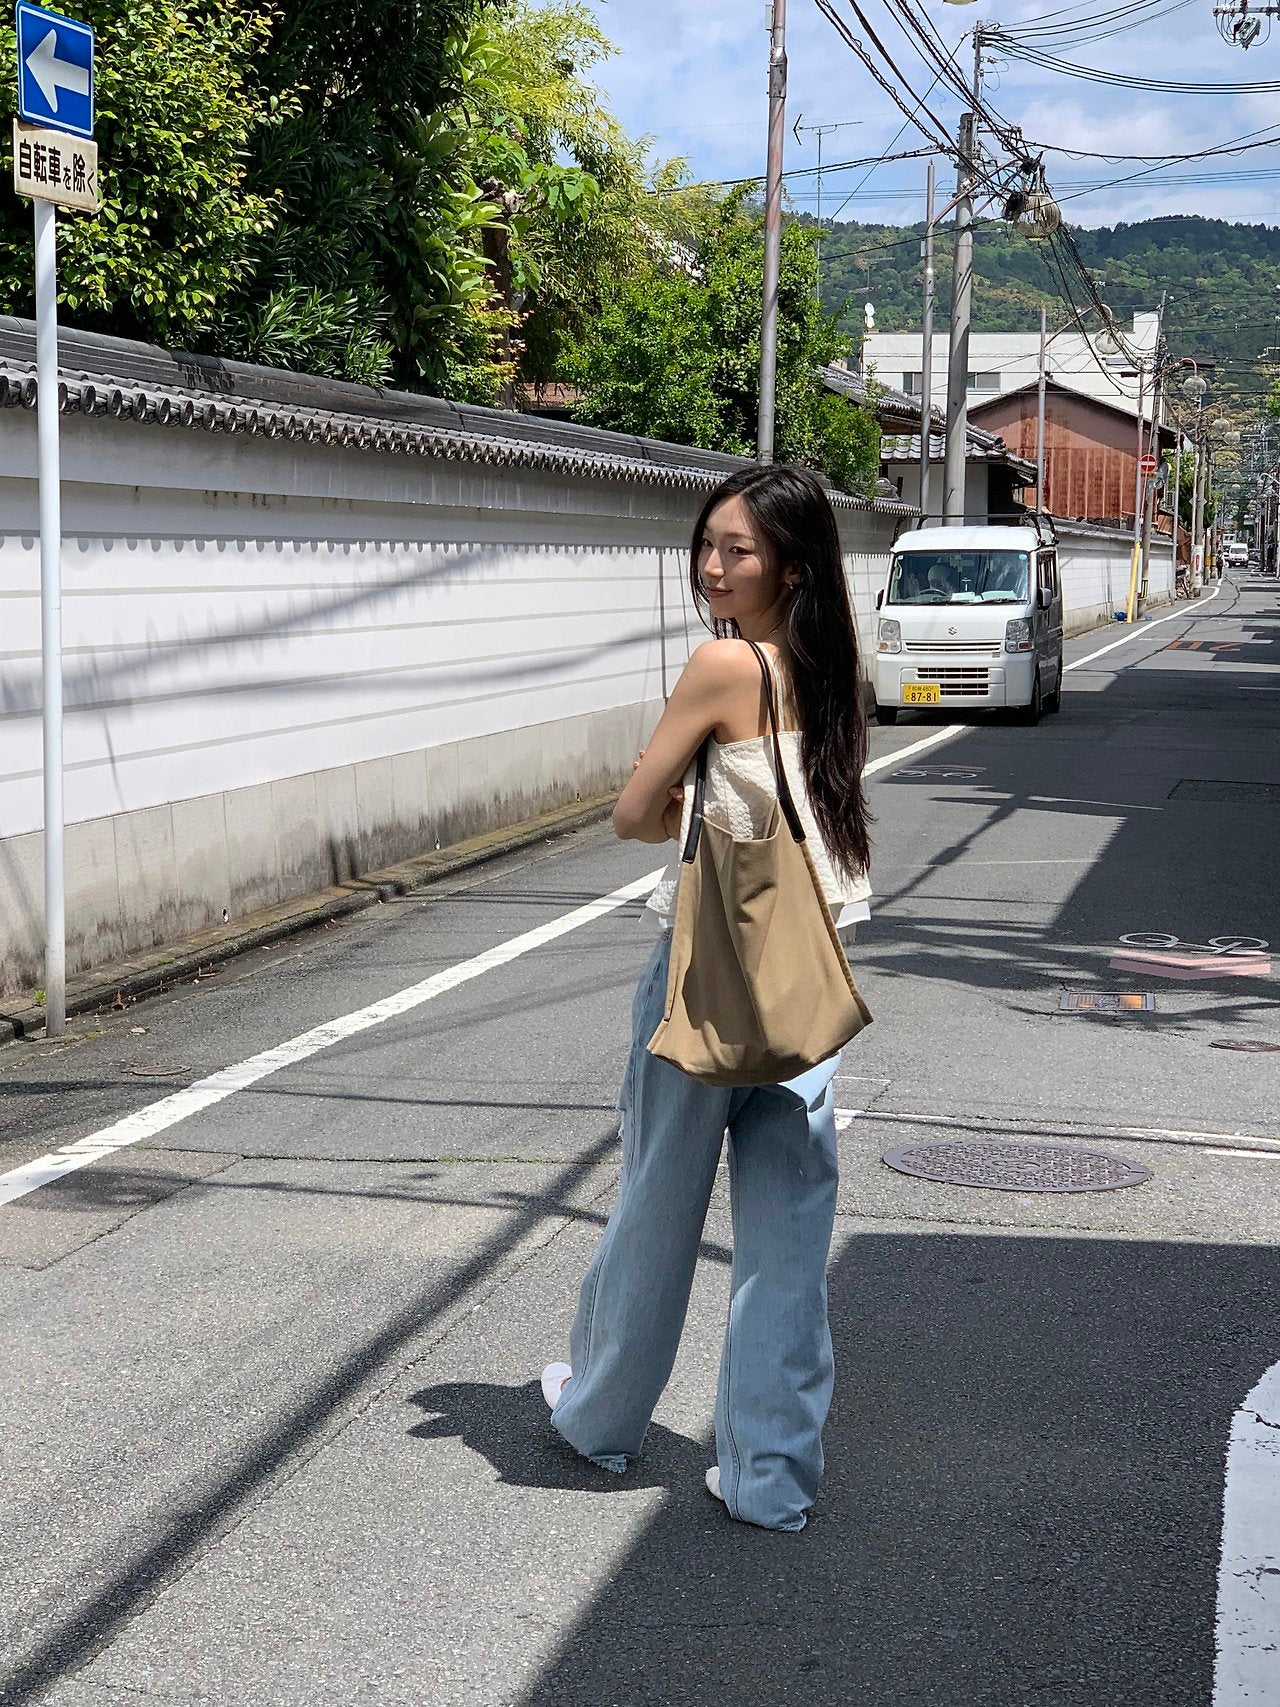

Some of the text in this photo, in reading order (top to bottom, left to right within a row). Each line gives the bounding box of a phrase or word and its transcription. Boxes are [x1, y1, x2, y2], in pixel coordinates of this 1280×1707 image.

[20, 138, 94, 196] 自転車を除く
[911, 692, 936, 702] 87-81
